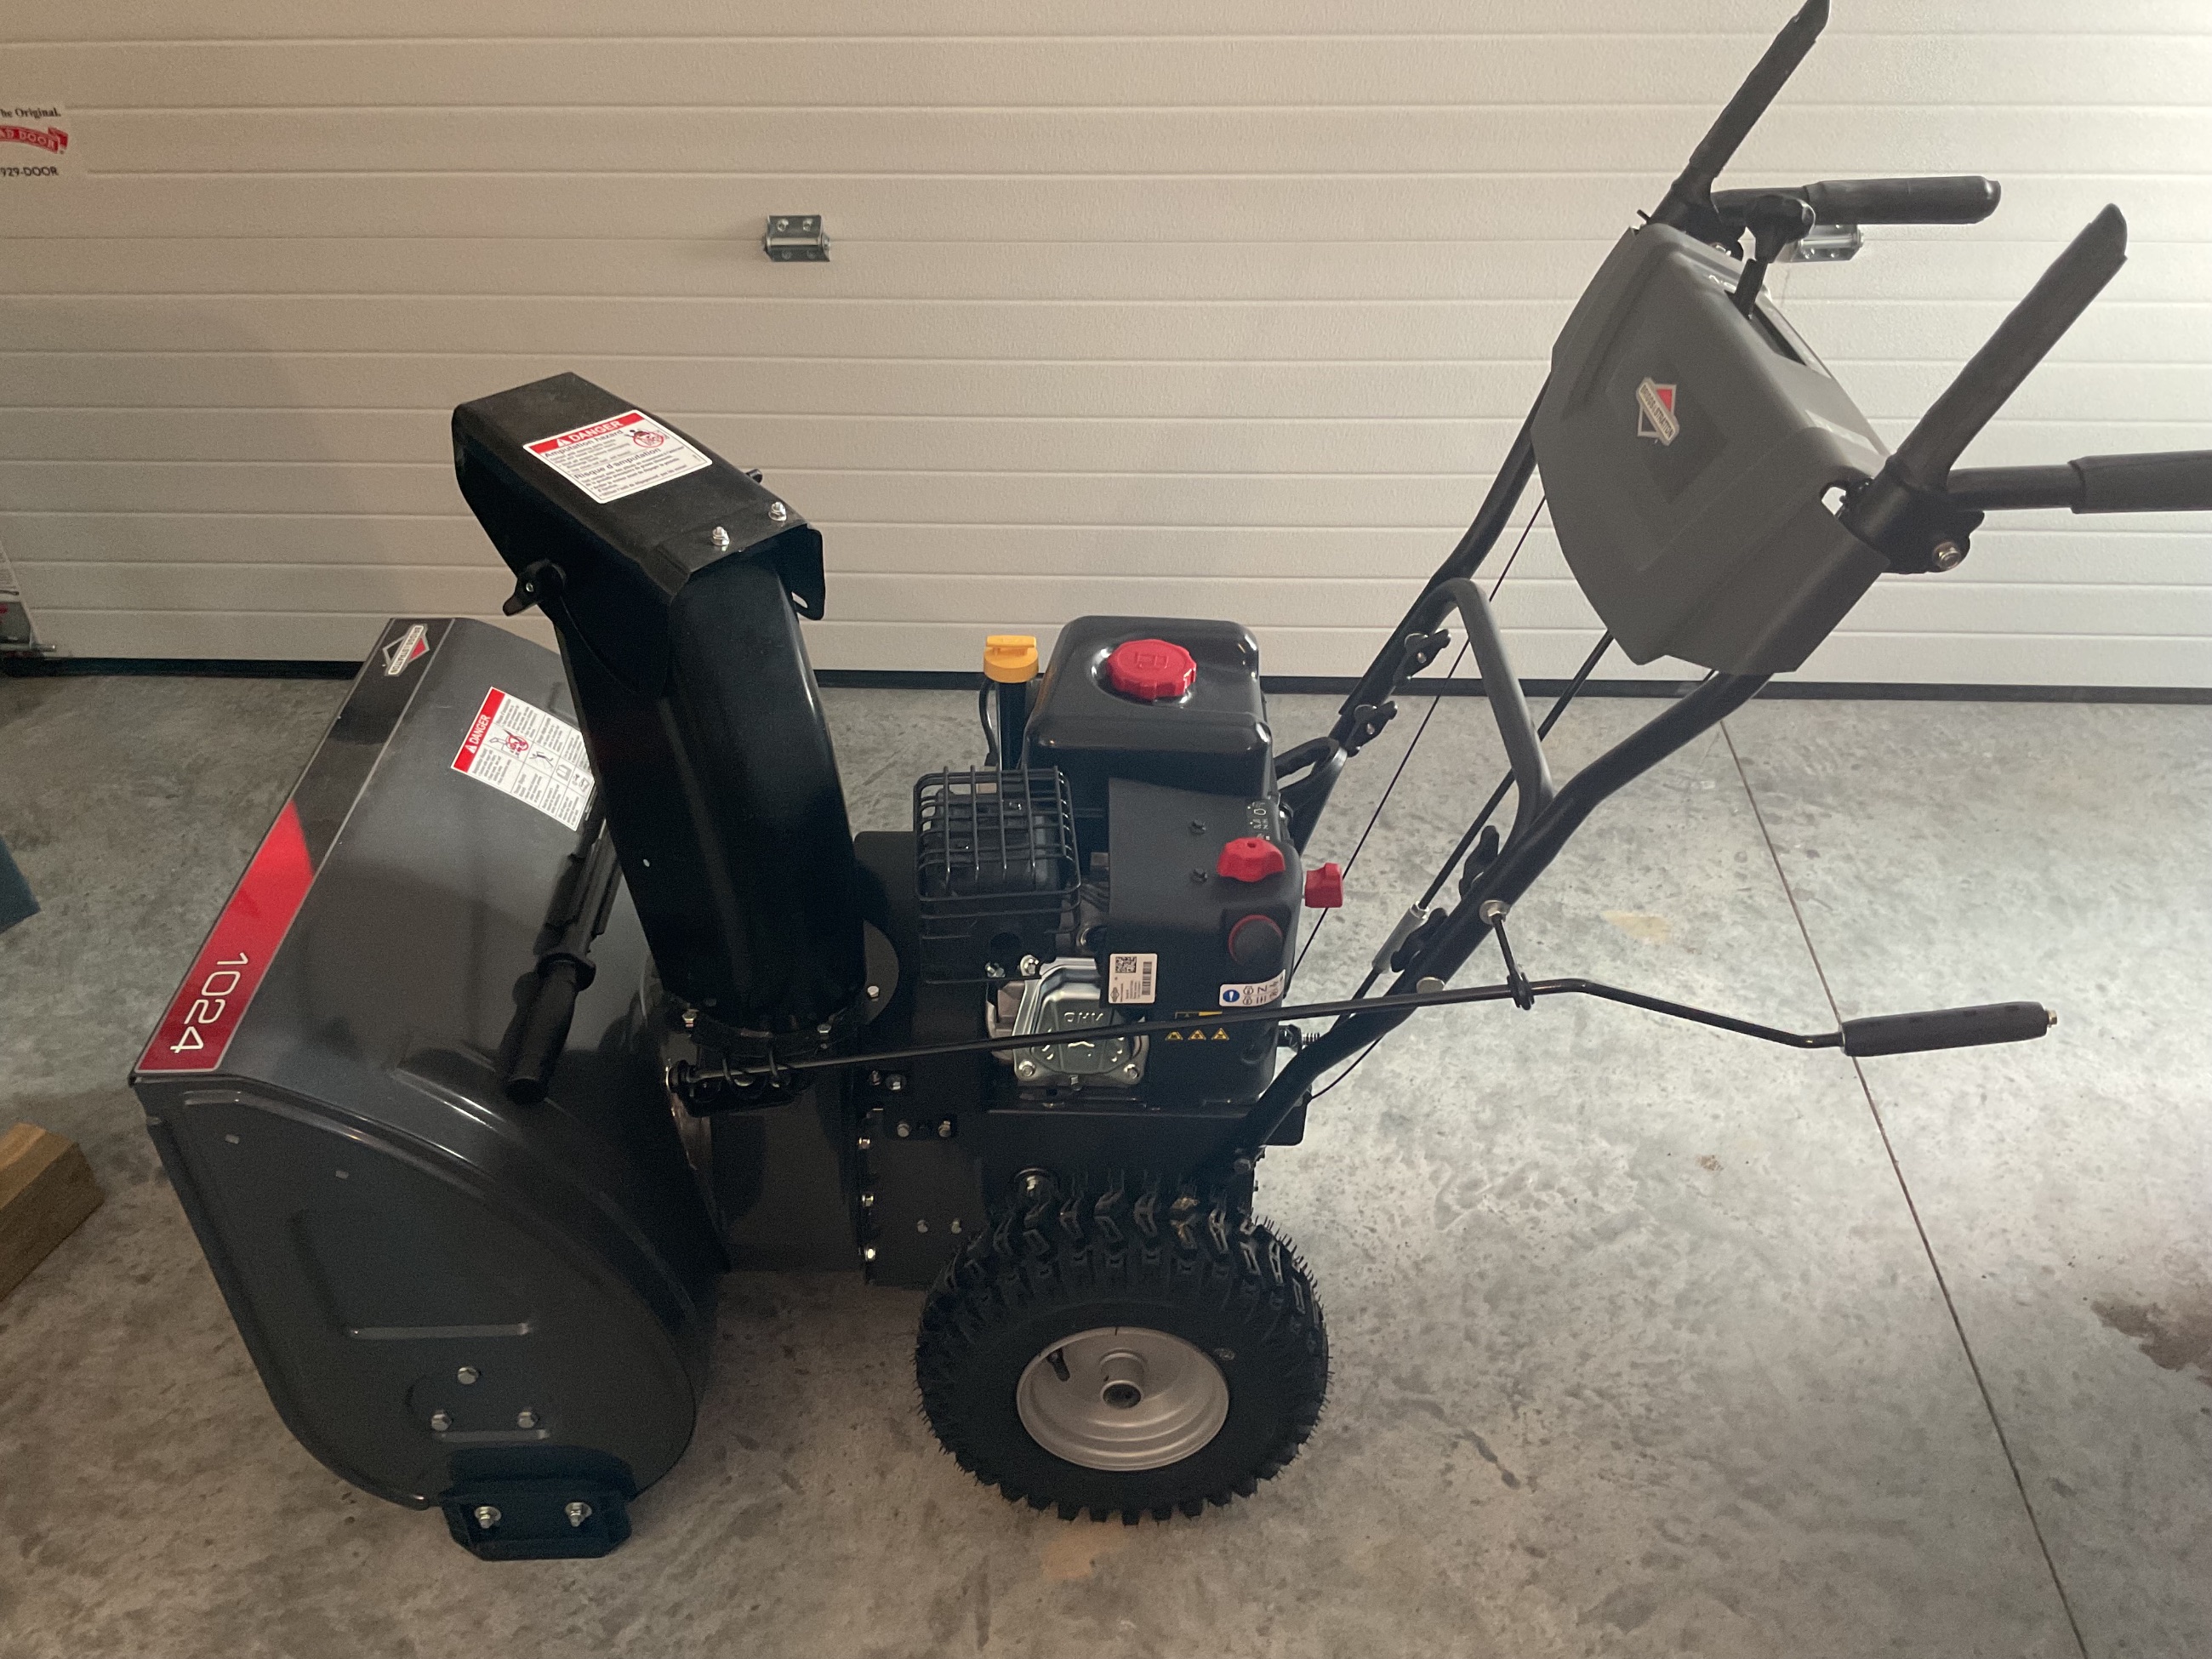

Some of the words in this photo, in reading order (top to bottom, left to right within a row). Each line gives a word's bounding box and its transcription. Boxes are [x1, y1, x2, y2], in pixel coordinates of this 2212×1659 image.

[544, 439, 594, 458] Amputation
[595, 429, 624, 442] hazard
[568, 420, 623, 442] DANGER
[573, 466, 606, 480] Risque
[469, 715, 491, 744] DANGER
[170, 951, 250, 1054] 1024
